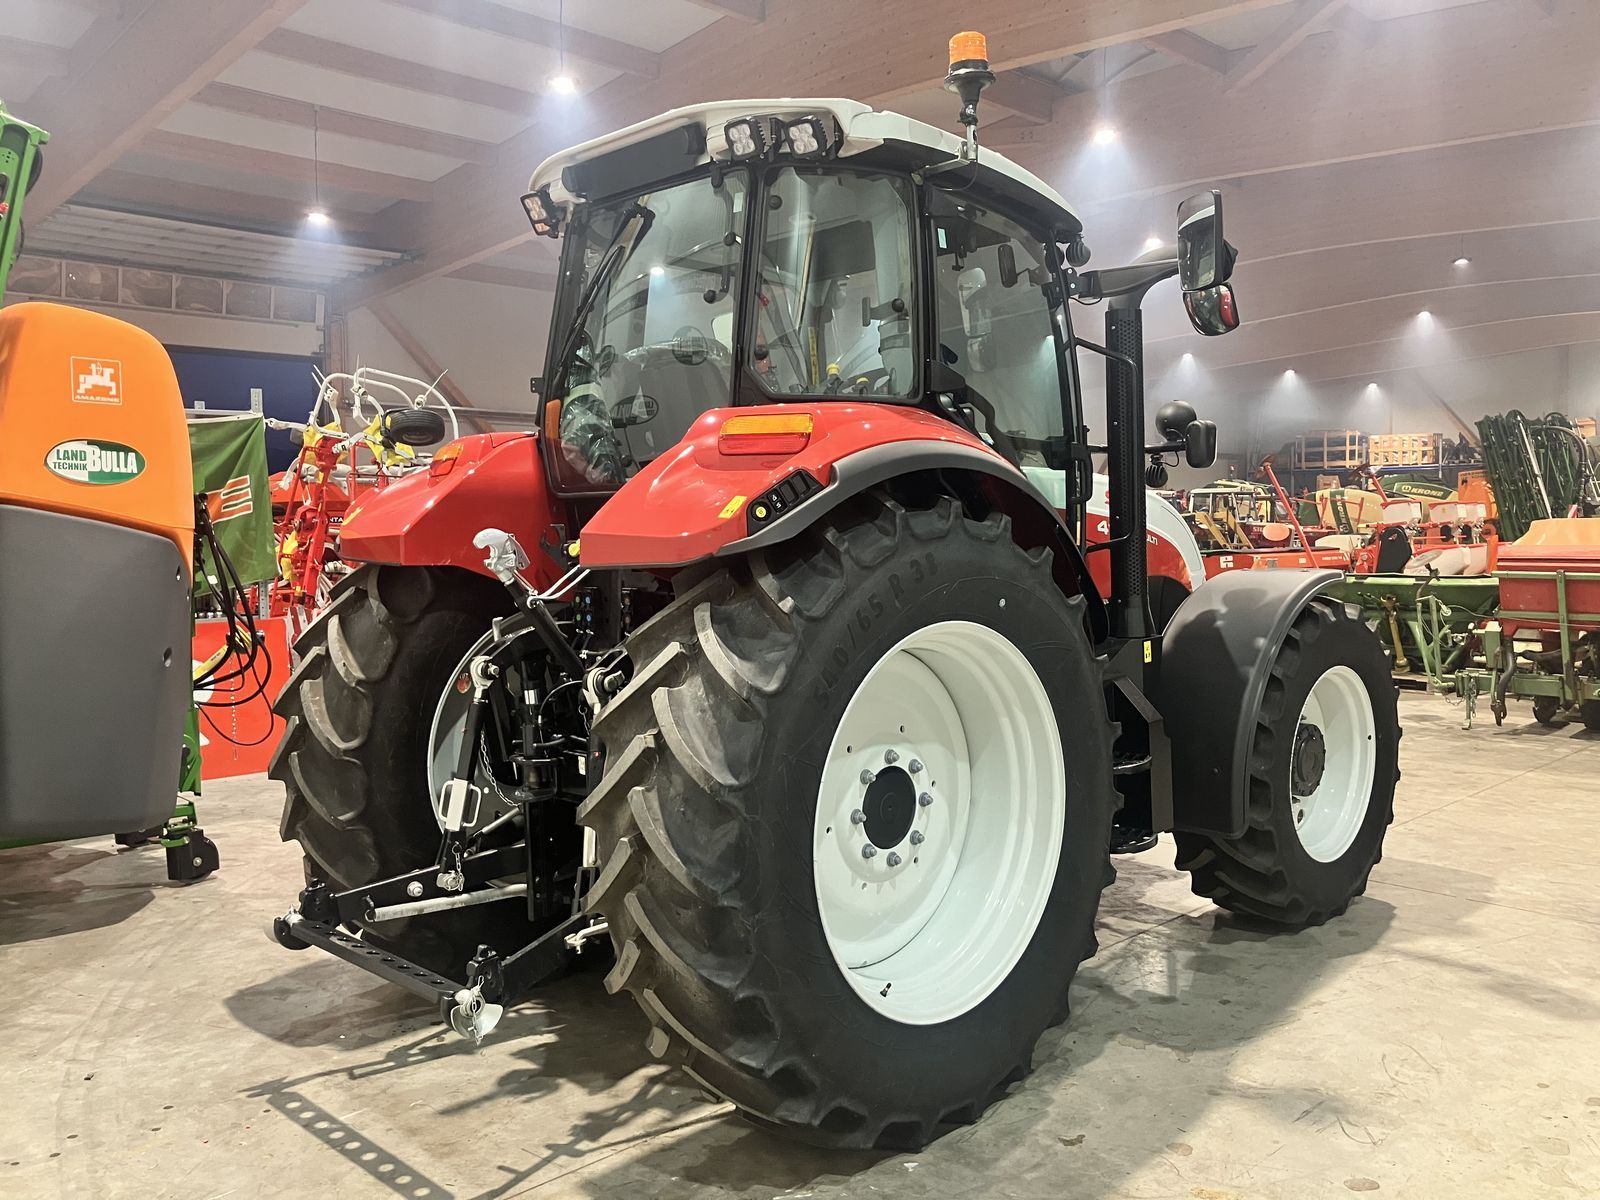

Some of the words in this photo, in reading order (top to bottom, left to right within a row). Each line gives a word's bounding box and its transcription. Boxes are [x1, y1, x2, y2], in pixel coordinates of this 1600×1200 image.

[75, 395, 119, 403] AMAZONE
[56, 449, 87, 461] LAND
[87, 445, 138, 473] BULLA
[52, 461, 88, 471] TECHNIK
[1411, 487, 1445, 497] KRONE
